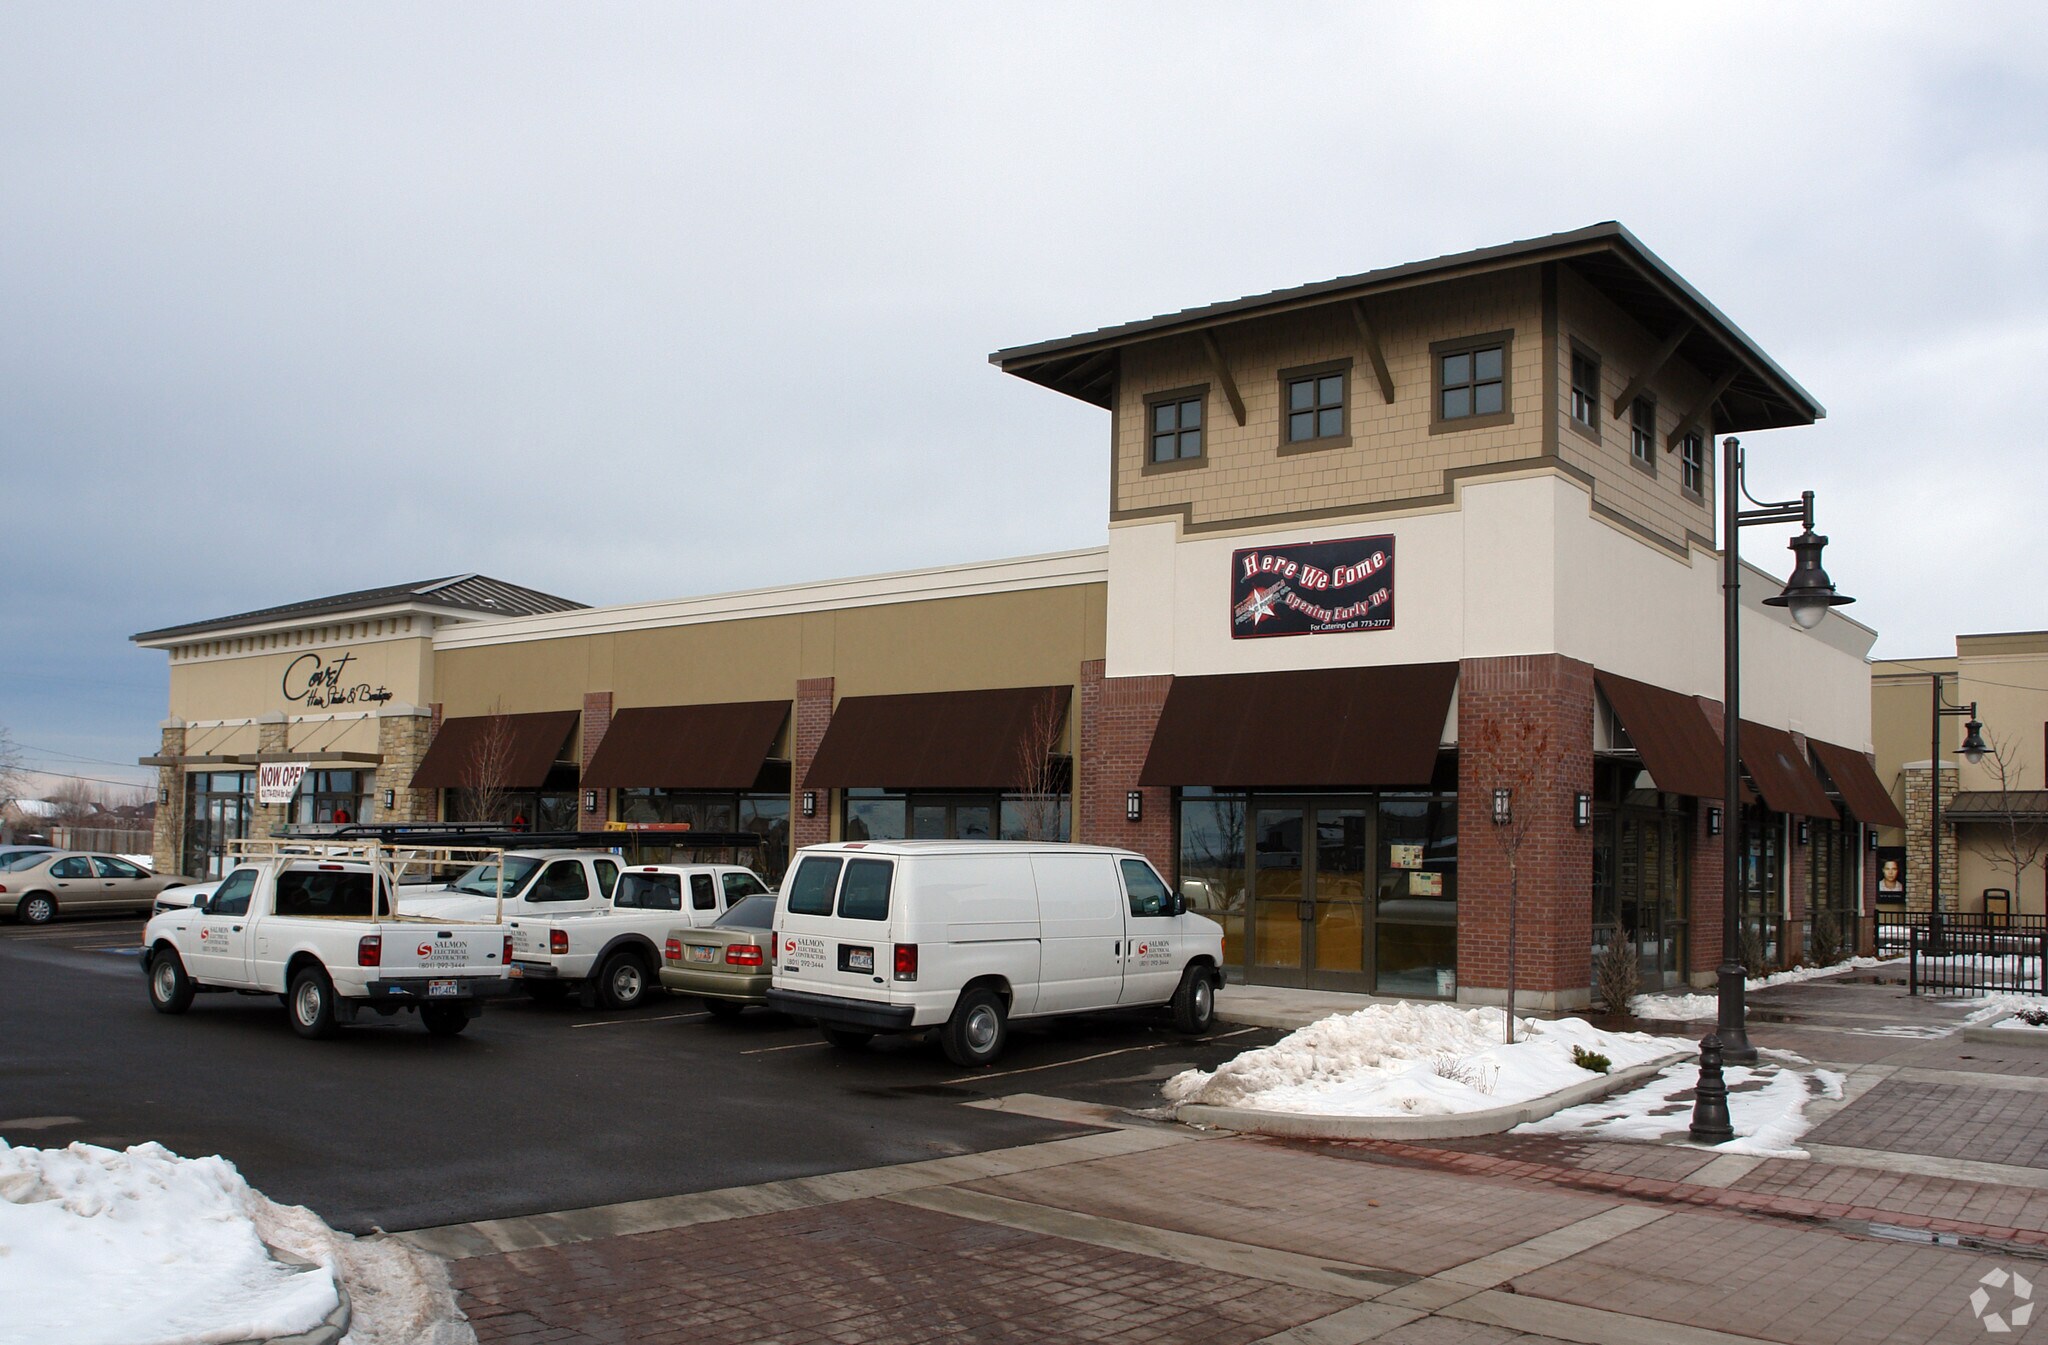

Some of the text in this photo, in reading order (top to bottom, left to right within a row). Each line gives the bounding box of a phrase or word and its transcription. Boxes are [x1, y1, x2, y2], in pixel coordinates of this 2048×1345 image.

[1243, 551, 1386, 591] Here We Come
[1285, 592, 1332, 623] Opening
[1333, 600, 1369, 621] Early
[1368, 588, 1389, 607] '09
[1321, 623, 1346, 631] Catering
[1361, 619, 1391, 627] 773-2777
[283, 652, 357, 701] Covet
[347, 687, 356, 704] &
[262, 767, 281, 786] NOW
[797, 938, 825, 947] SALMON
[797, 946, 824, 954] ELECTRICAL
[801, 960, 824, 968] 292-3444
